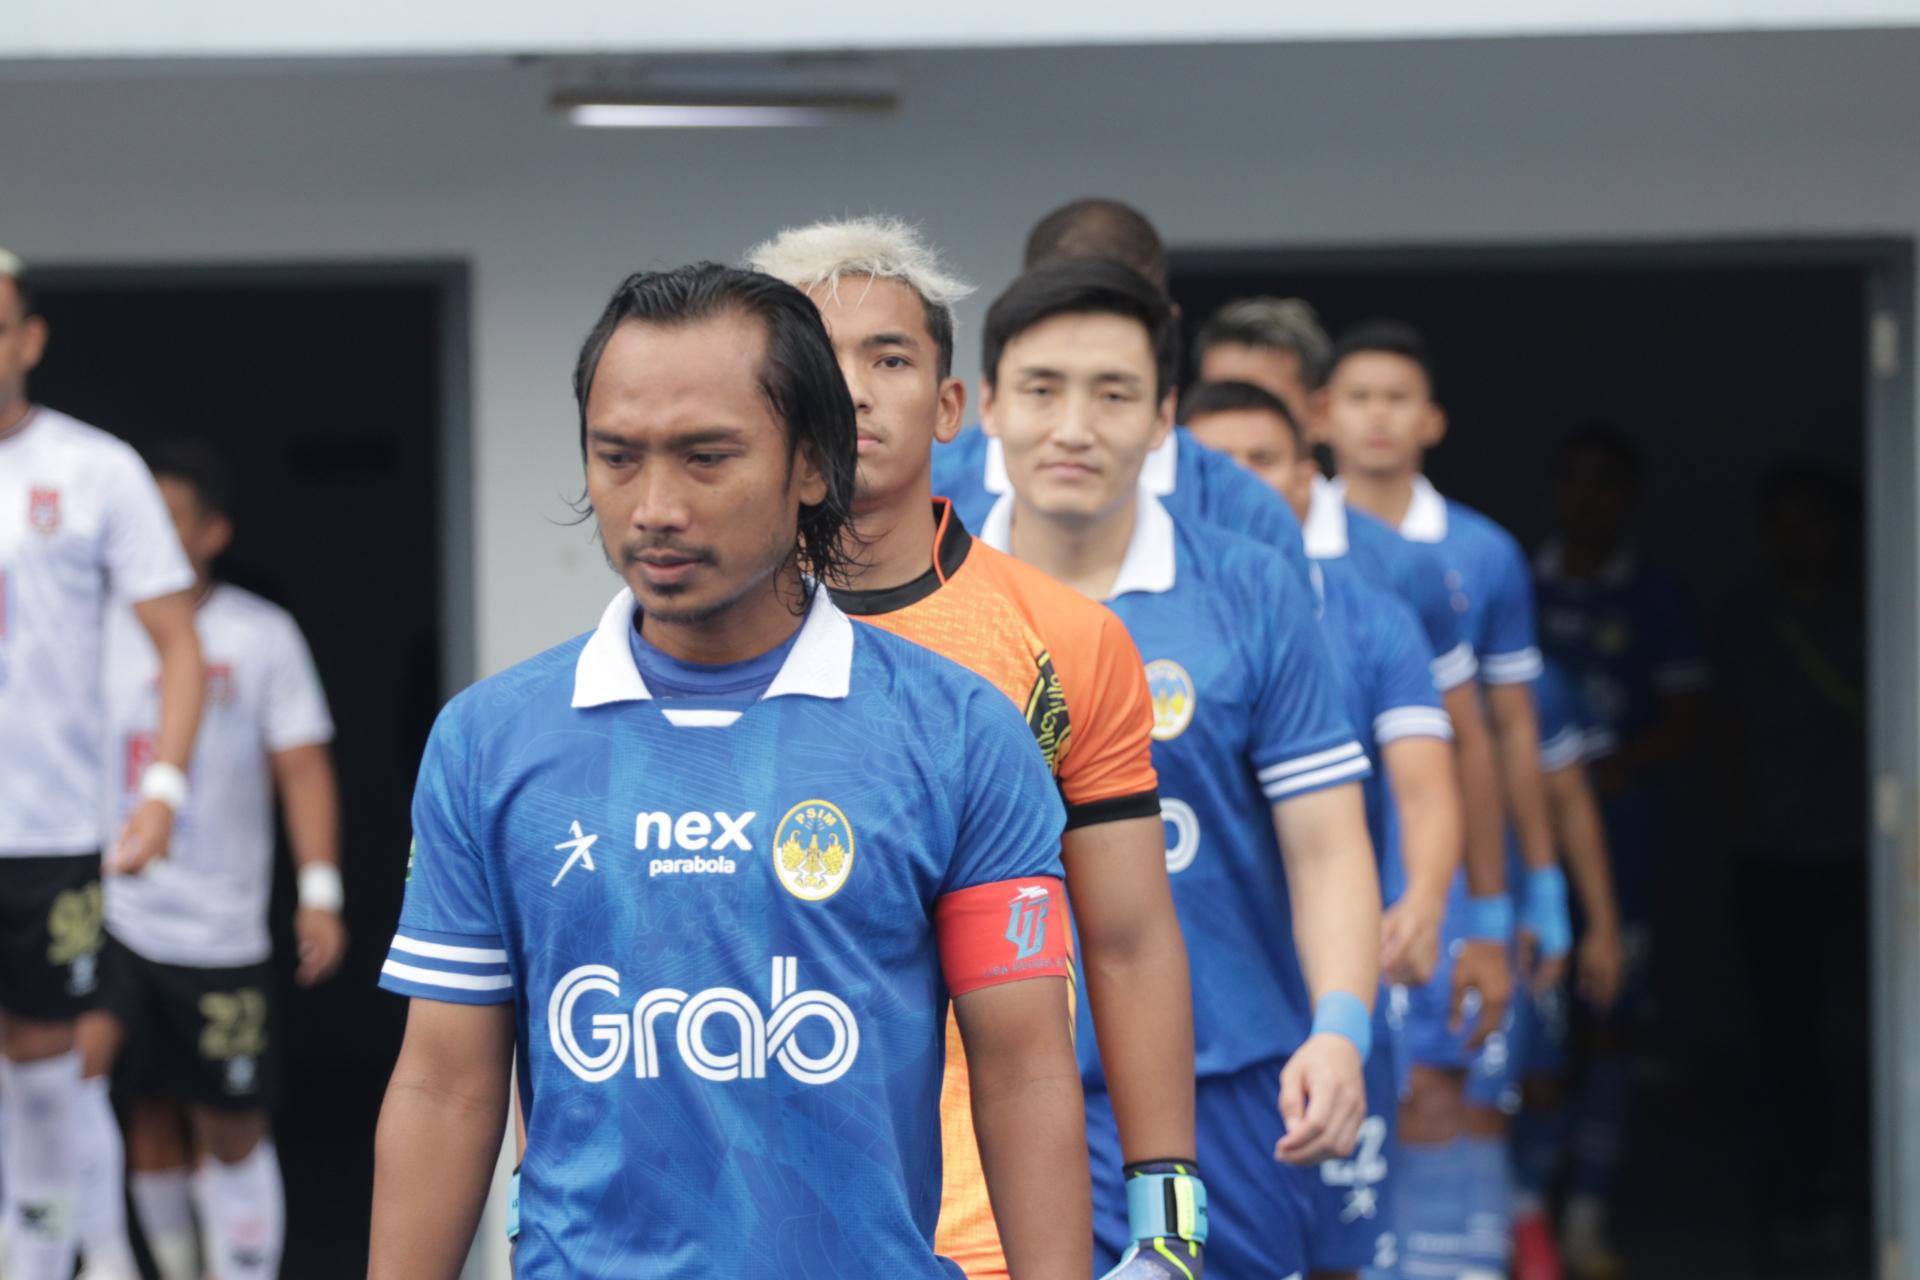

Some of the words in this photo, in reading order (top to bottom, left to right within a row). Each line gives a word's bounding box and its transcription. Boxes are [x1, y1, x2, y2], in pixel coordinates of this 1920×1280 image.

[634, 811, 756, 850] nex
[795, 808, 837, 826] PSIM
[649, 855, 736, 876] parabola
[548, 956, 859, 1085] Grab
[1320, 1114, 1388, 1186] 2
